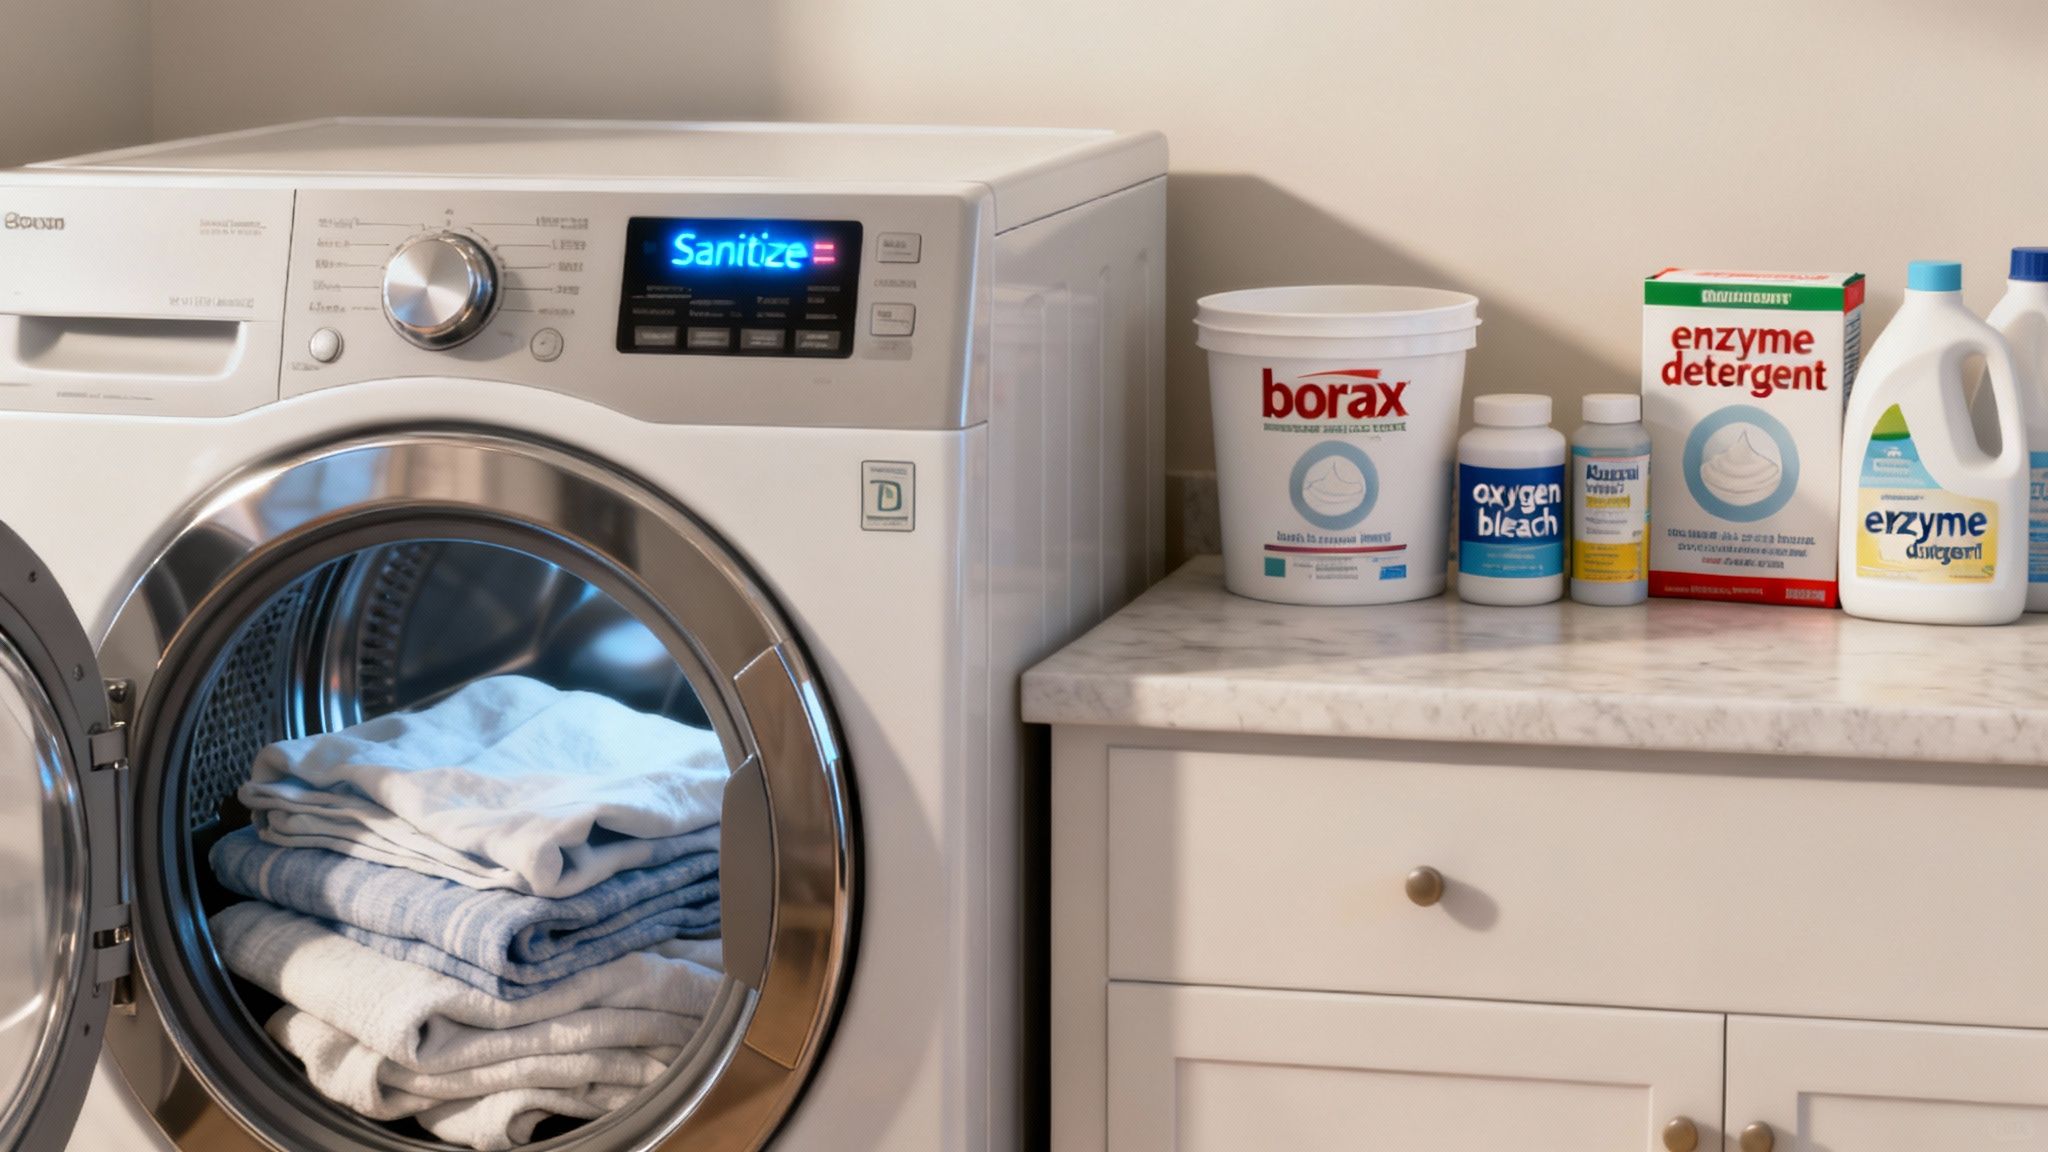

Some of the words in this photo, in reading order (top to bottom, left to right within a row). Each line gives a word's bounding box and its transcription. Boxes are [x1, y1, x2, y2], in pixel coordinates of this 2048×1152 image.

[671, 232, 809, 269] Sanitize
[1671, 325, 1815, 361] enzyme
[1661, 350, 1828, 398] detergent
[1262, 368, 1409, 420] borax
[1472, 483, 1562, 515] oxygen
[1478, 507, 1559, 538] bleach
